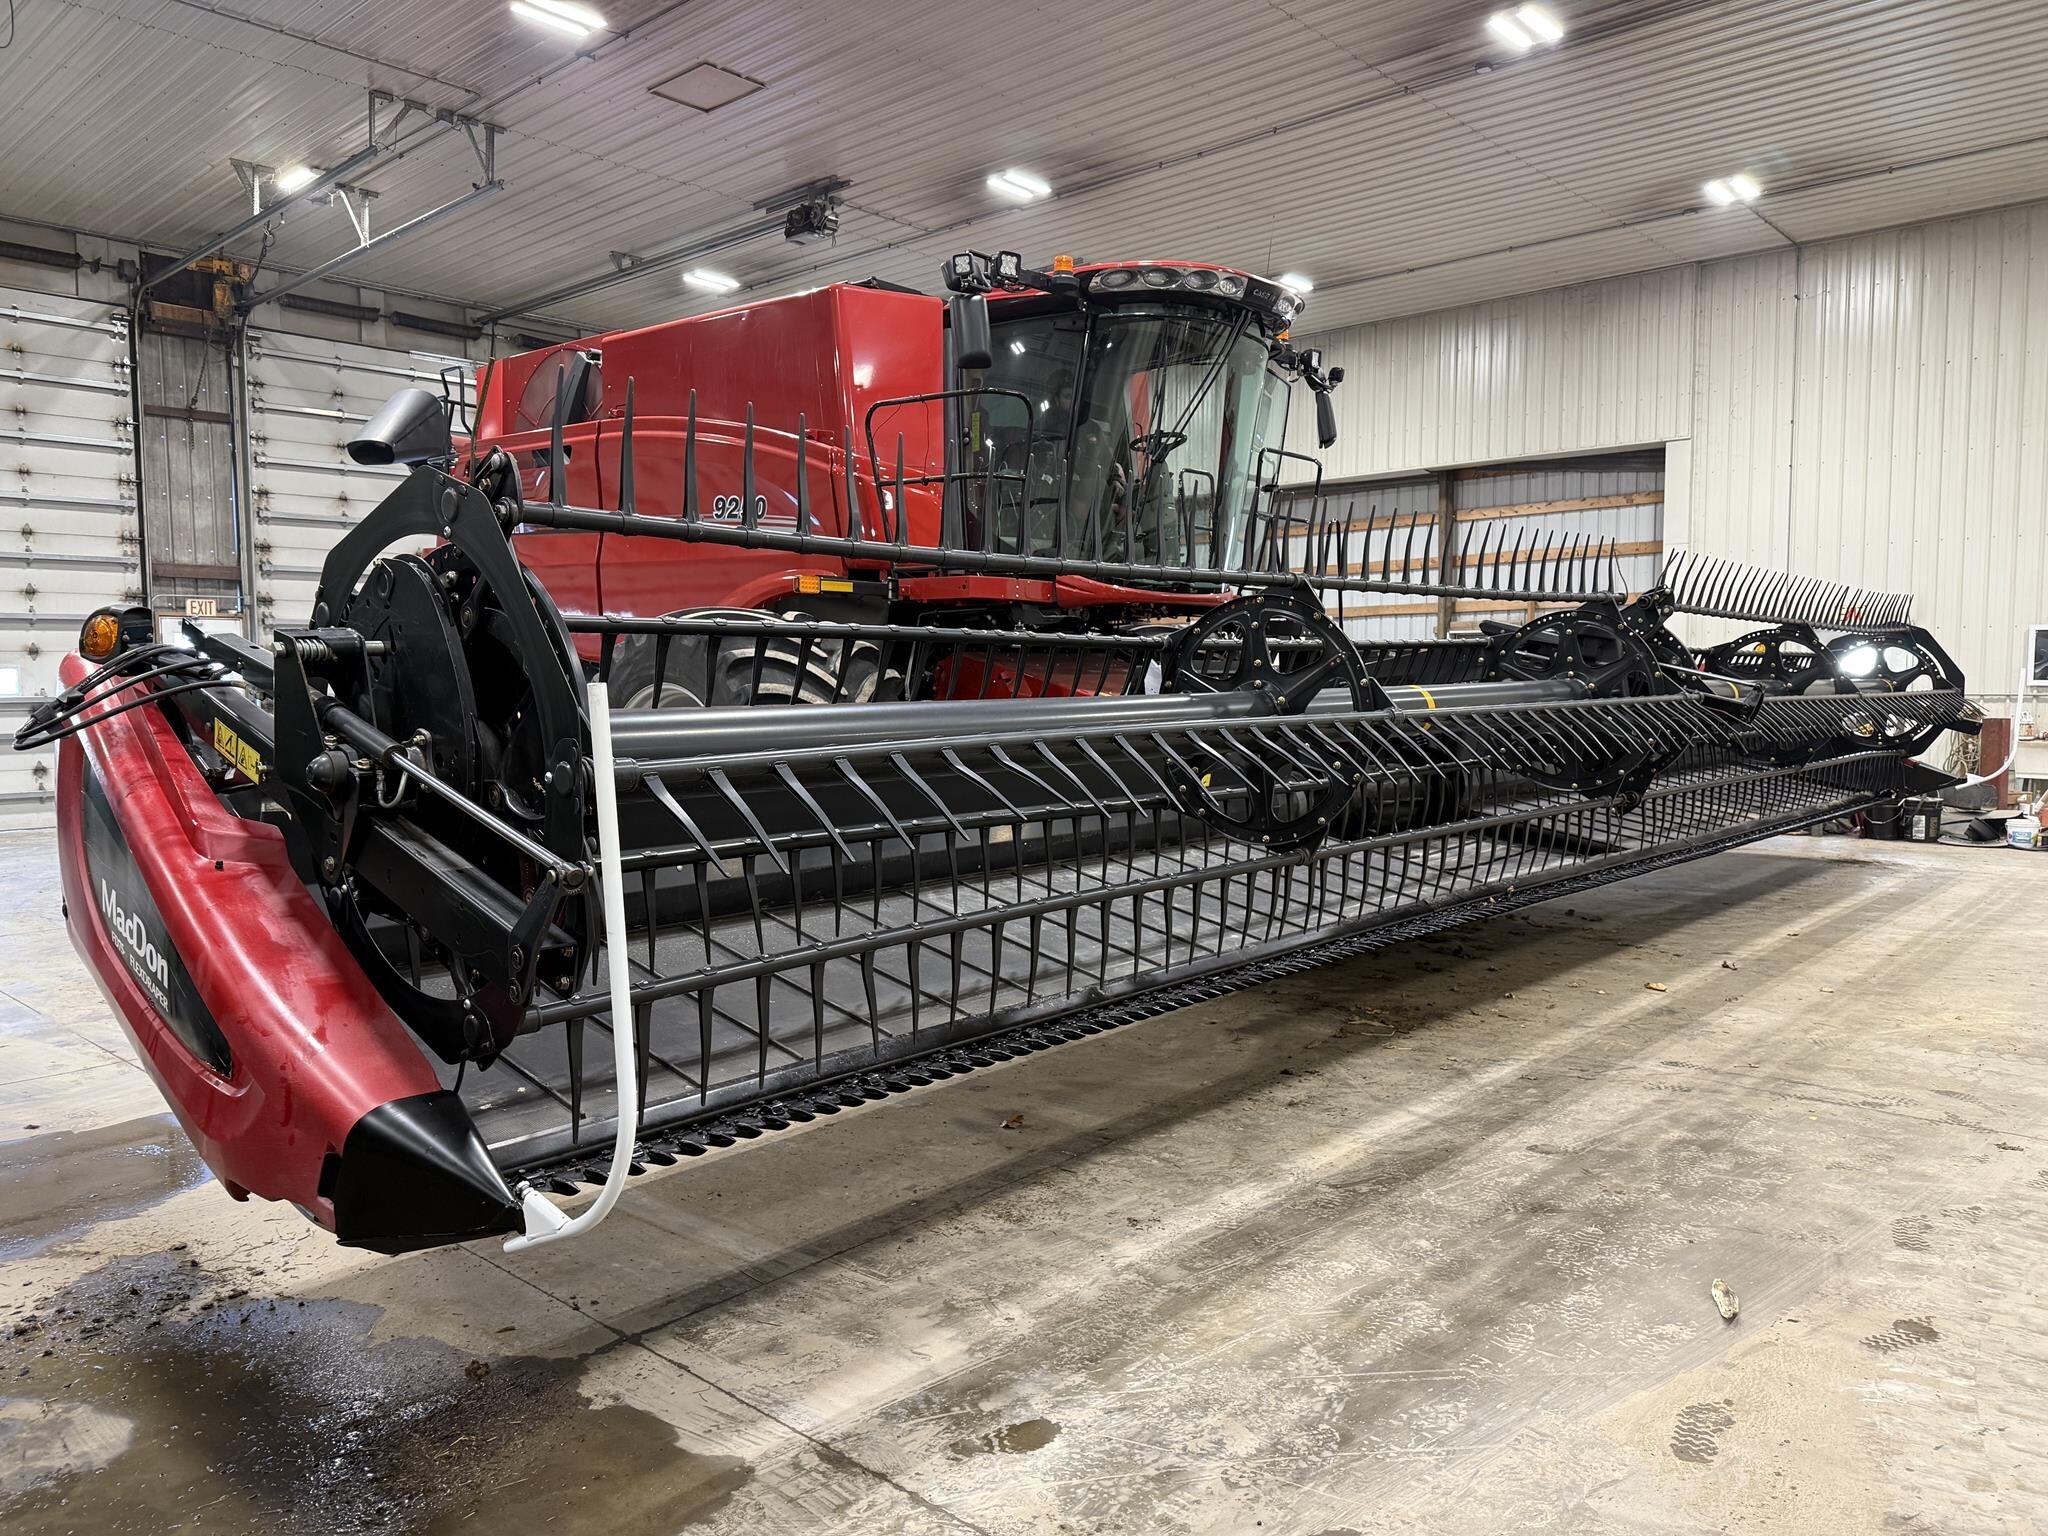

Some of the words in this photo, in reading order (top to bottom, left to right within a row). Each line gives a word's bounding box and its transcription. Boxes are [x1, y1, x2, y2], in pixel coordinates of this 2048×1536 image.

[713, 495, 768, 520] 920
[190, 600, 214, 615] EXIT
[101, 878, 169, 990] MacDon
[129, 953, 169, 1012] FLEXDRAPER
